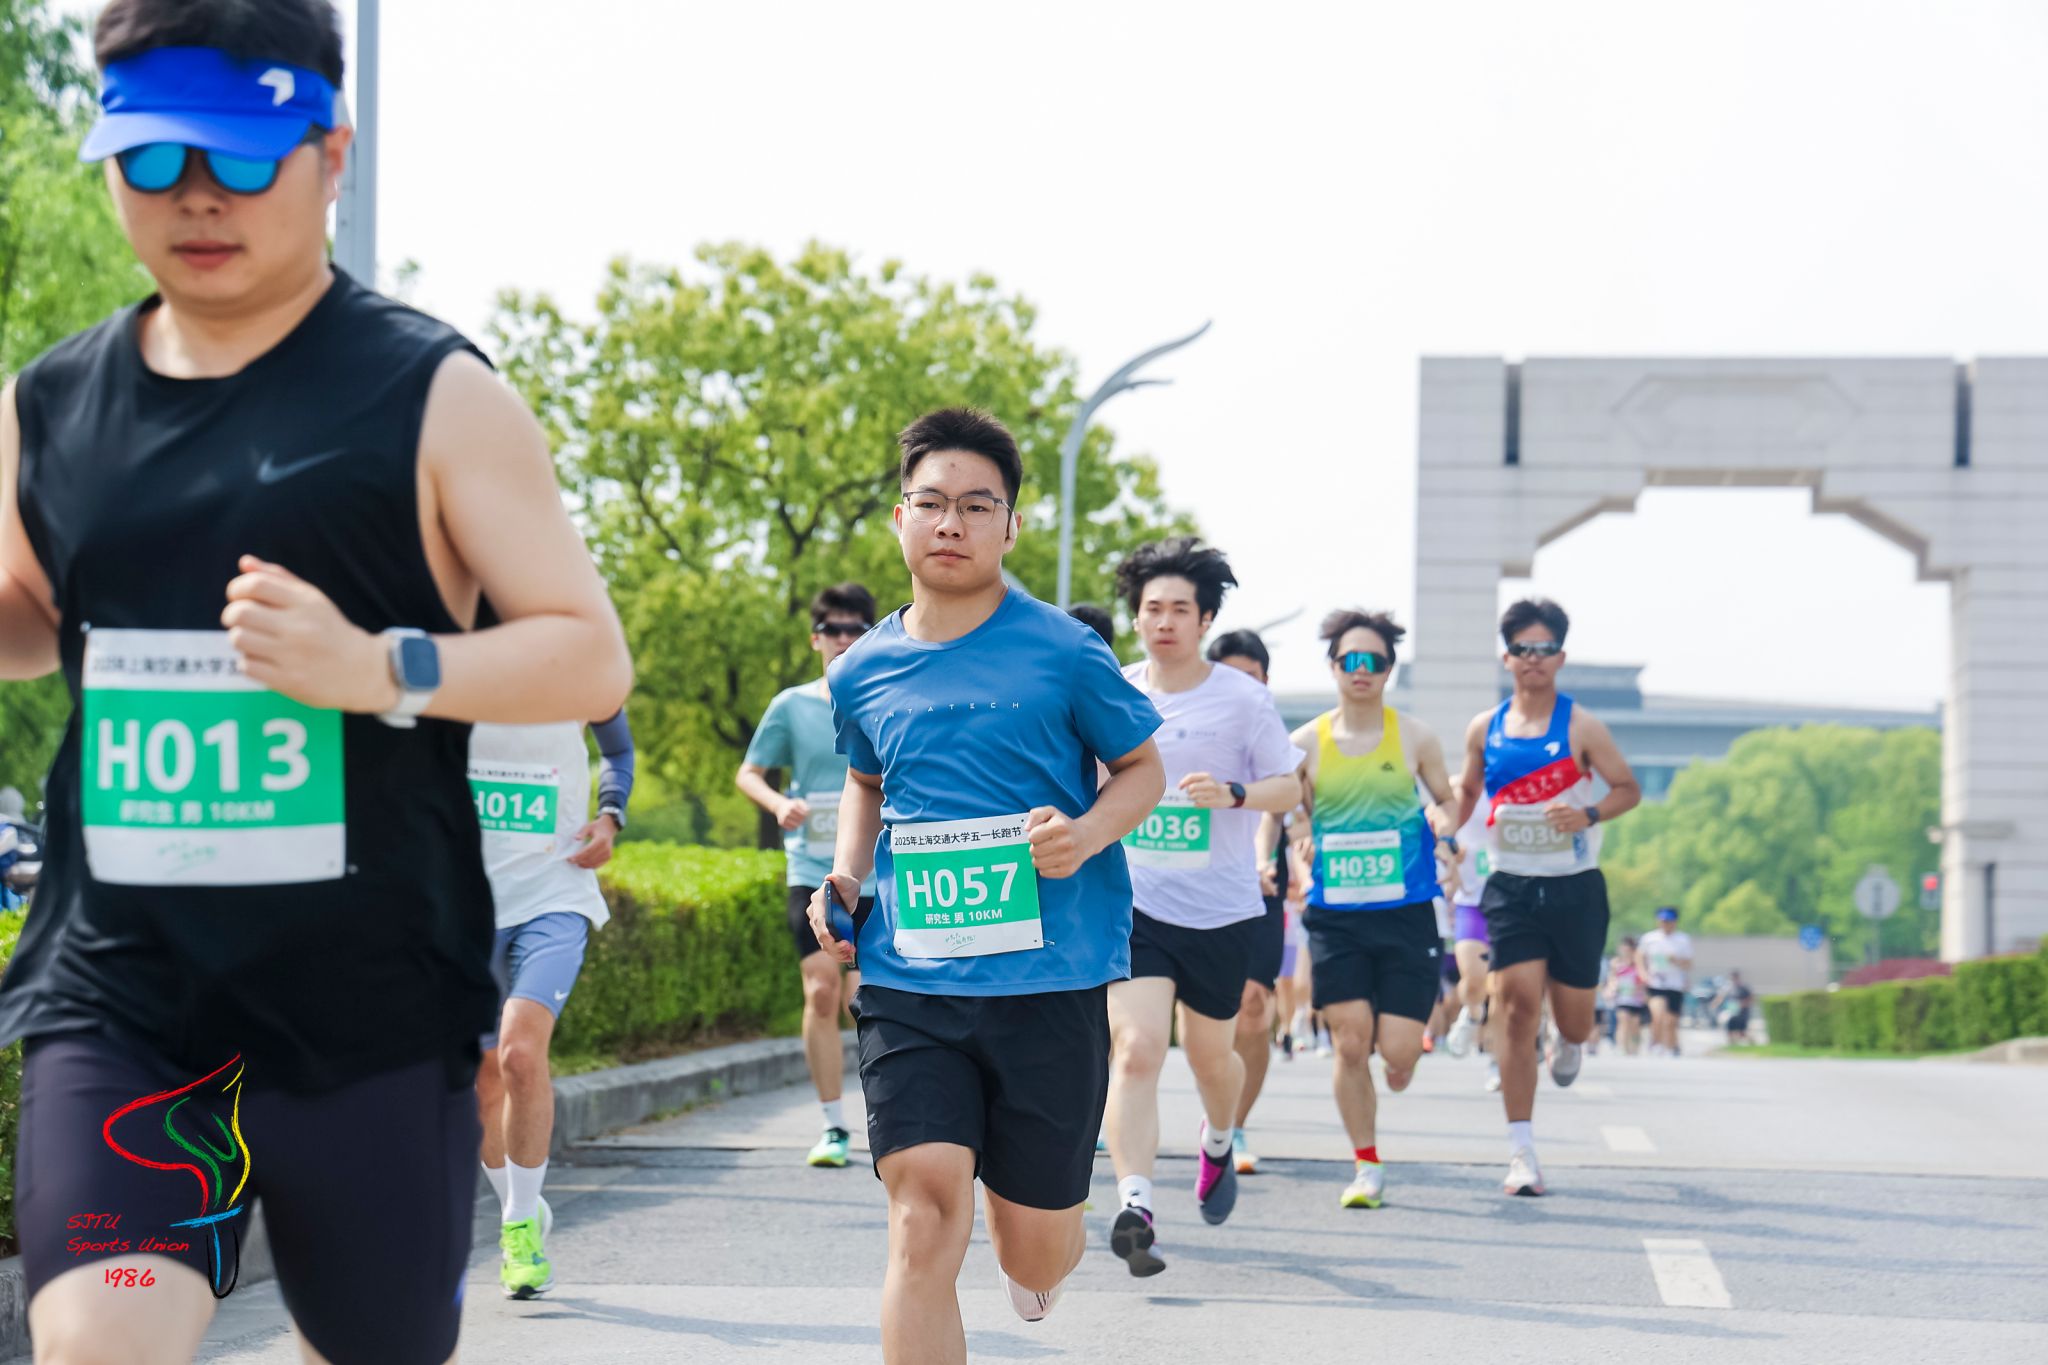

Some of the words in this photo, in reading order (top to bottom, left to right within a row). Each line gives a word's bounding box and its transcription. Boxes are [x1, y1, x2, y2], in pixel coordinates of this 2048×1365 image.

[874, 702, 1020, 723] ANTATECH
[97, 718, 311, 793] H013
[894, 826, 1022, 846] 2025年上海交通大学五一长跑节
[1329, 854, 1395, 879] H039
[906, 862, 1019, 908] H057
[925, 913, 951, 925] 研究生
[954, 911, 965, 924] 男
[968, 908, 1003, 921] 10KM
